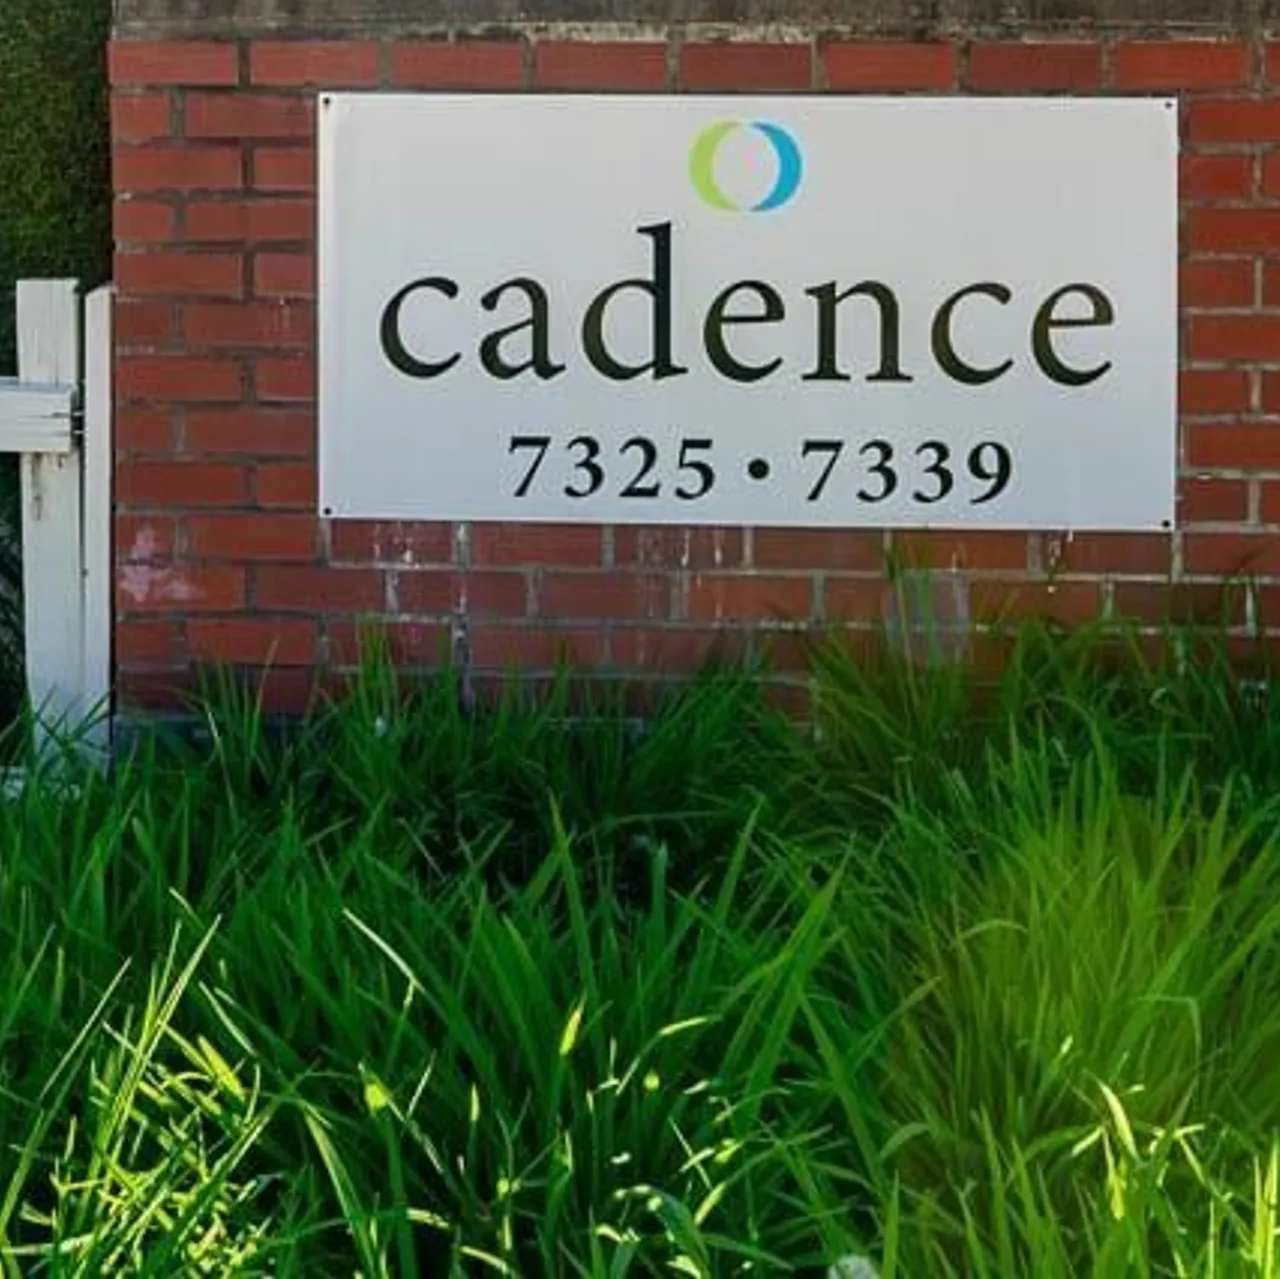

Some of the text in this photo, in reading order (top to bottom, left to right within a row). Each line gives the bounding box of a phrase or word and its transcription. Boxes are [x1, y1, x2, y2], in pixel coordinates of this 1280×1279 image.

[379, 220, 1115, 387] cadence
[507, 435, 716, 500] 7325
[800, 438, 1012, 505] 7339
